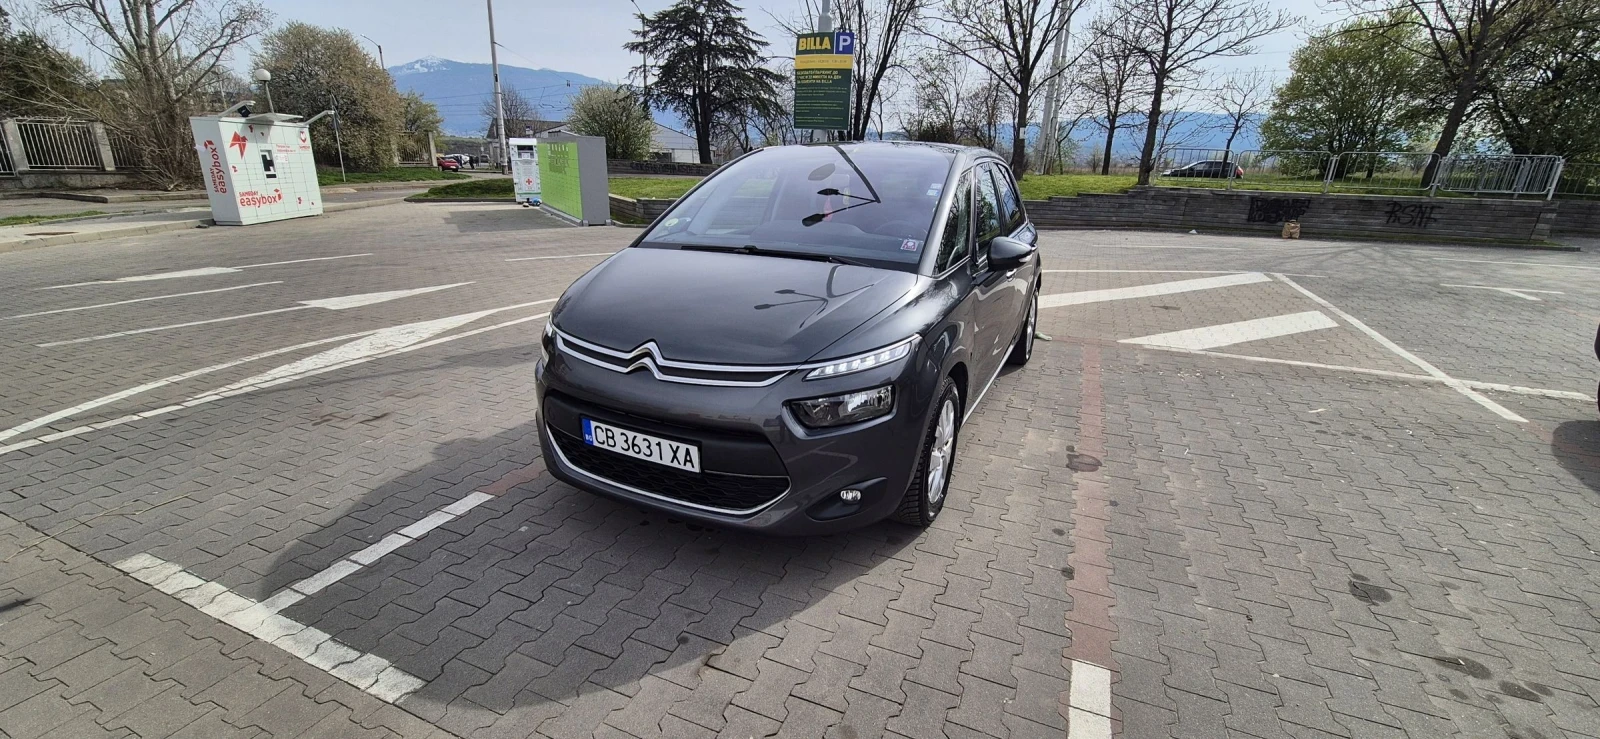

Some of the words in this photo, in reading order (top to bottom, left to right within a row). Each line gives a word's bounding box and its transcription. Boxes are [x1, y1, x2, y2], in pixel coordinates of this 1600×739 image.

[799, 37, 831, 50] BILLA
[839, 36, 851, 51] P
[210, 168, 219, 193] SAMEDAY
[211, 147, 227, 194] easybox
[240, 194, 278, 208] easybox
[585, 434, 592, 442] BG
[594, 425, 616, 448] CB
[620, 432, 663, 461] 3631
[669, 443, 695, 469] XA
